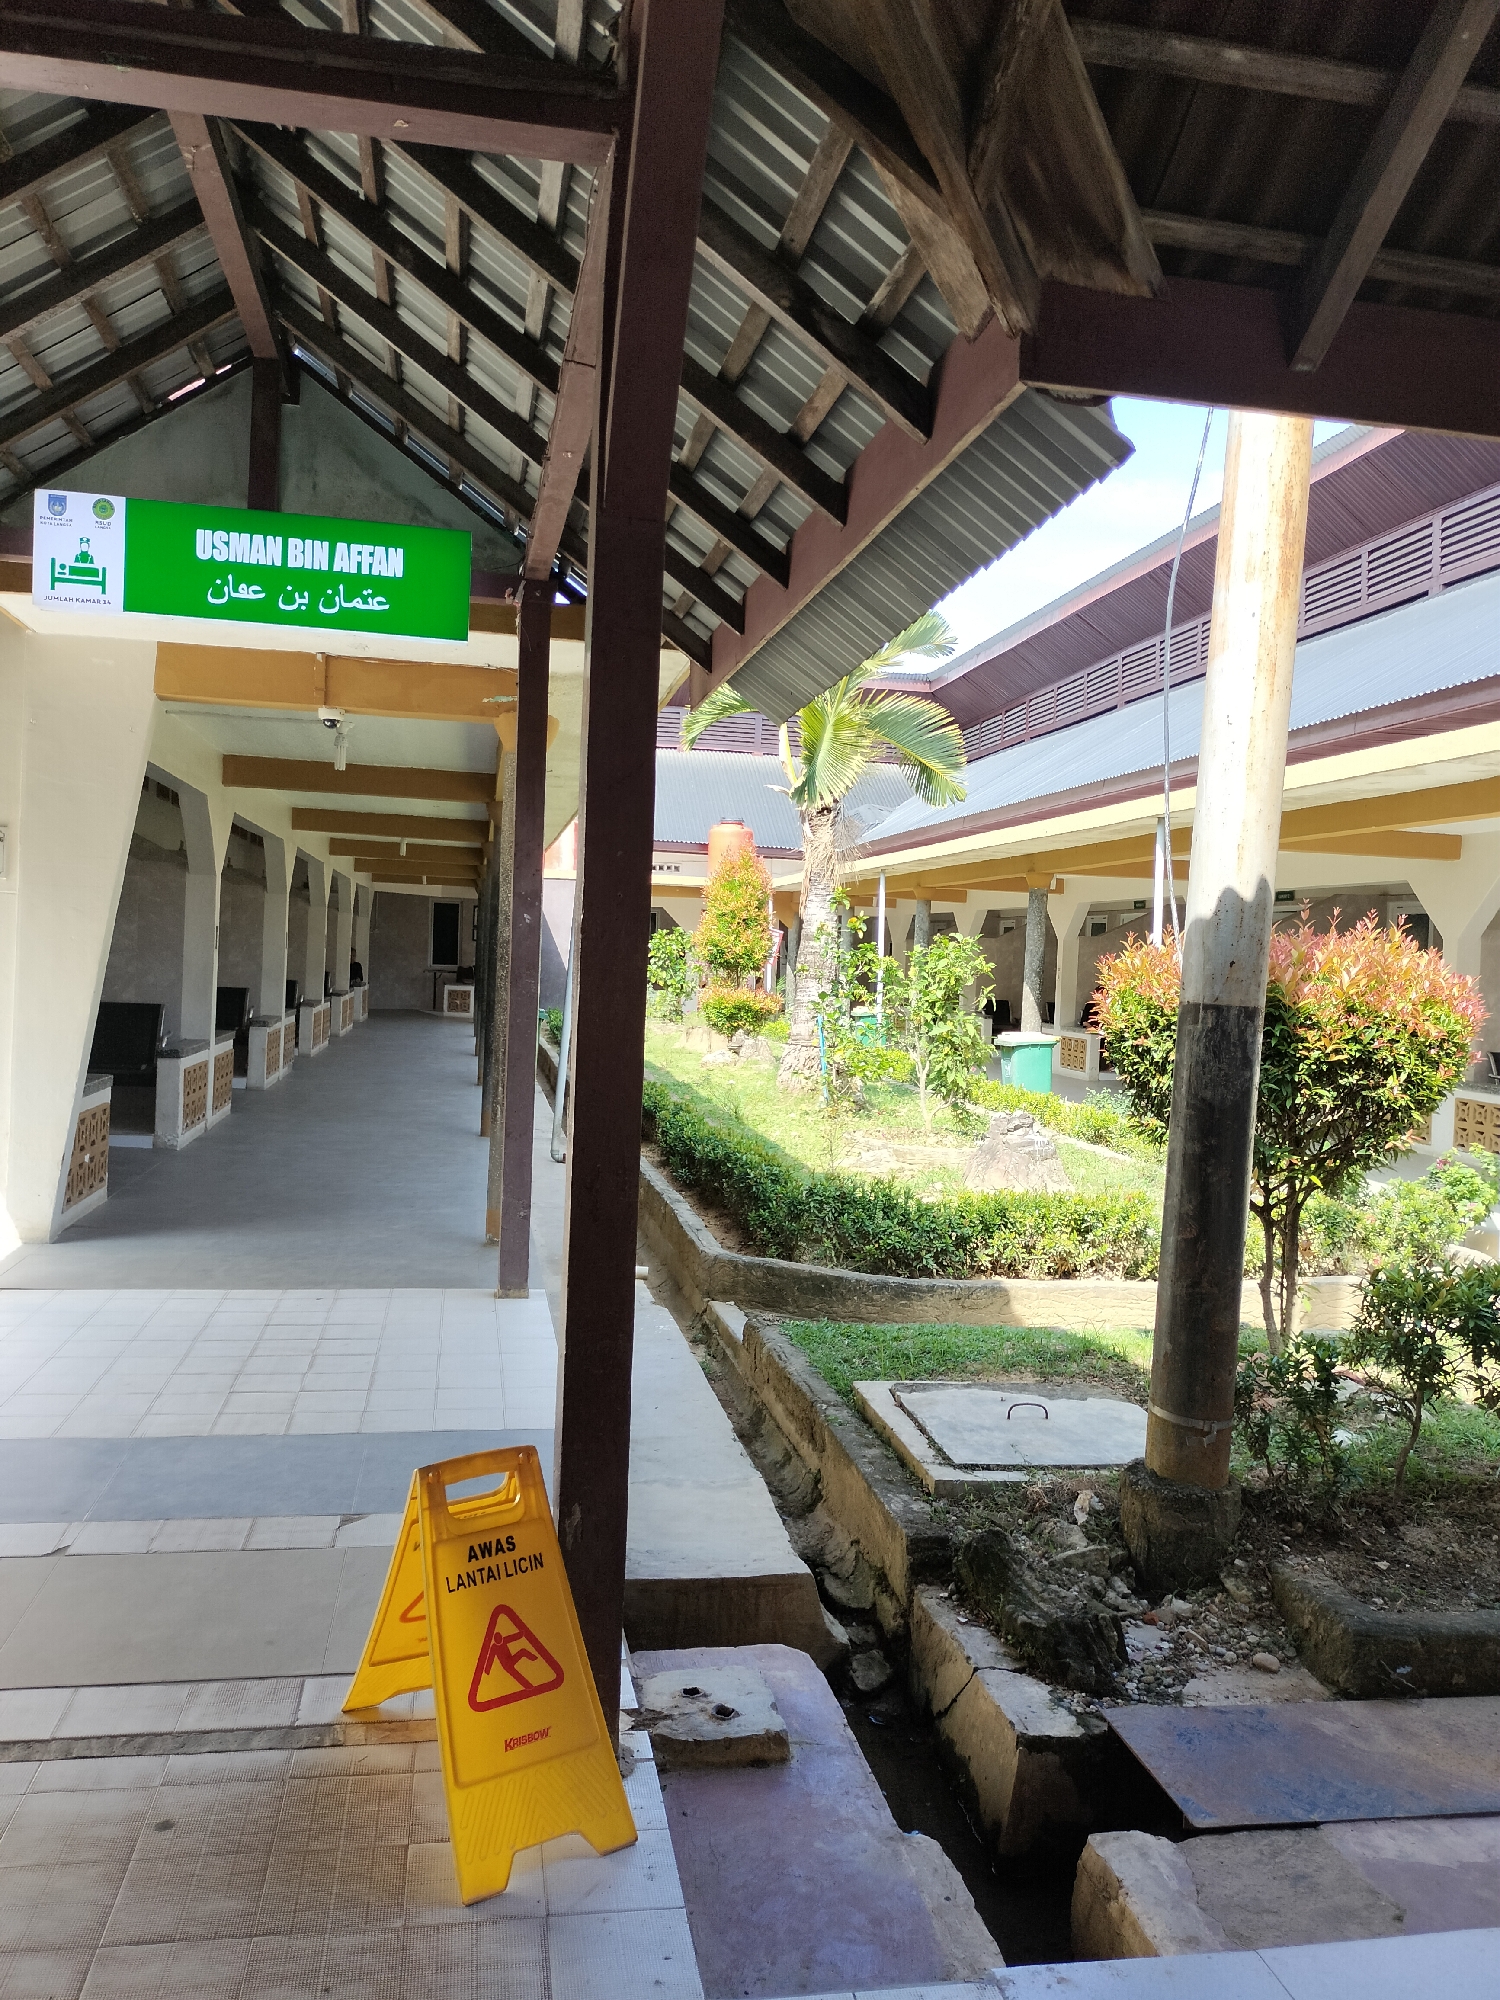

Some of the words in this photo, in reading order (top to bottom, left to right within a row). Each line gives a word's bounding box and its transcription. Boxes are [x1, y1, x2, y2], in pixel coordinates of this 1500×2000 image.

[196, 529, 282, 567] USMAN
[287, 538, 330, 571] BIN
[333, 542, 404, 578] AFFAN
[44, 595, 74, 603] JUMLAH
[75, 597, 102, 605] KAMAR
[278, 585, 309, 611] بن
[467, 1535, 517, 1563] AWAS
[445, 1564, 502, 1594] LANTAI
[503, 1552, 544, 1579] LICIN
